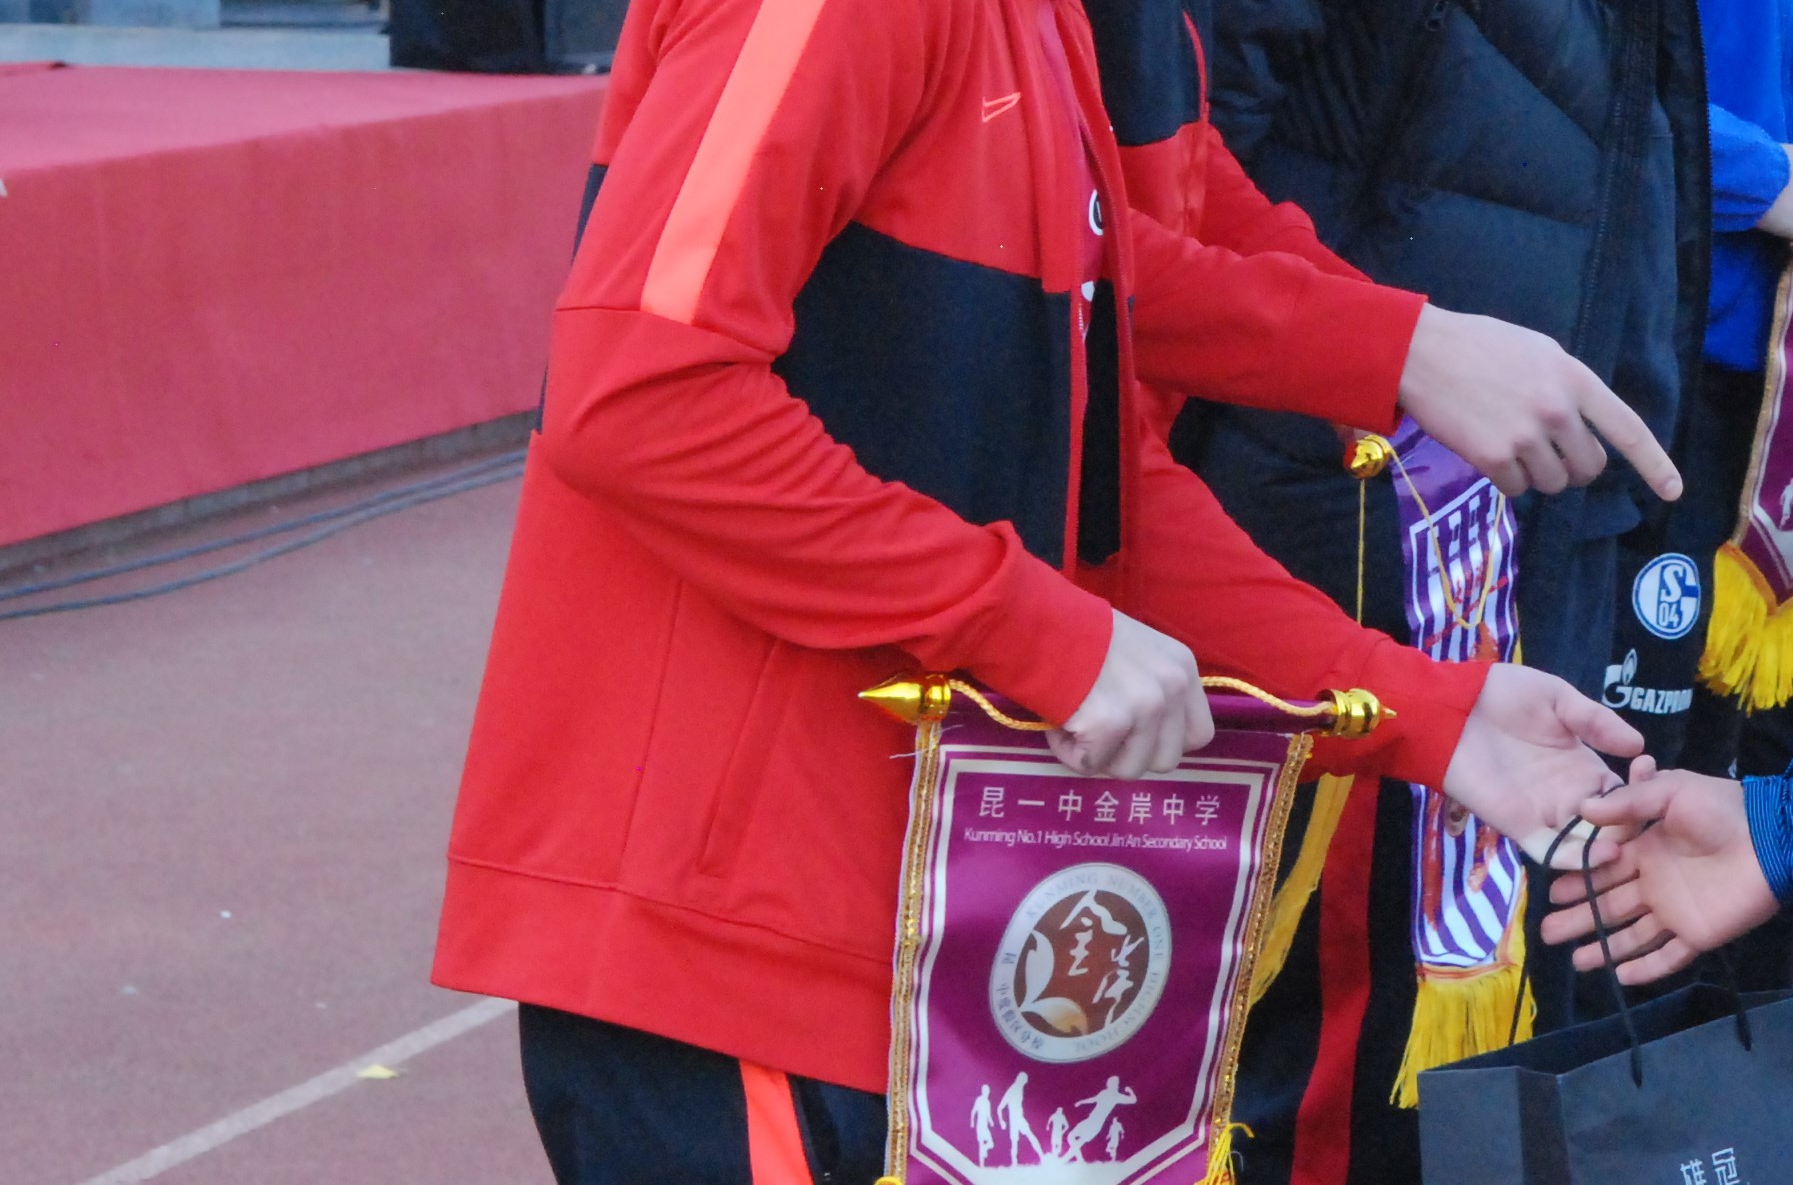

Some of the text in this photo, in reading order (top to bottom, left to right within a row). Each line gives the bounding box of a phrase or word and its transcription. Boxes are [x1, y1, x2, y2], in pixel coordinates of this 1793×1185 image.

[1658, 602, 1681, 628] 04
[979, 786, 1221, 826] 昆一中金岸中学
[964, 827, 1016, 847] Kunming
[1017, 829, 1042, 844] No.1
[1044, 830, 1072, 848] High
[1072, 830, 1109, 848] School
[1142, 833, 1193, 852] Secondary
[1194, 835, 1228, 851] School
